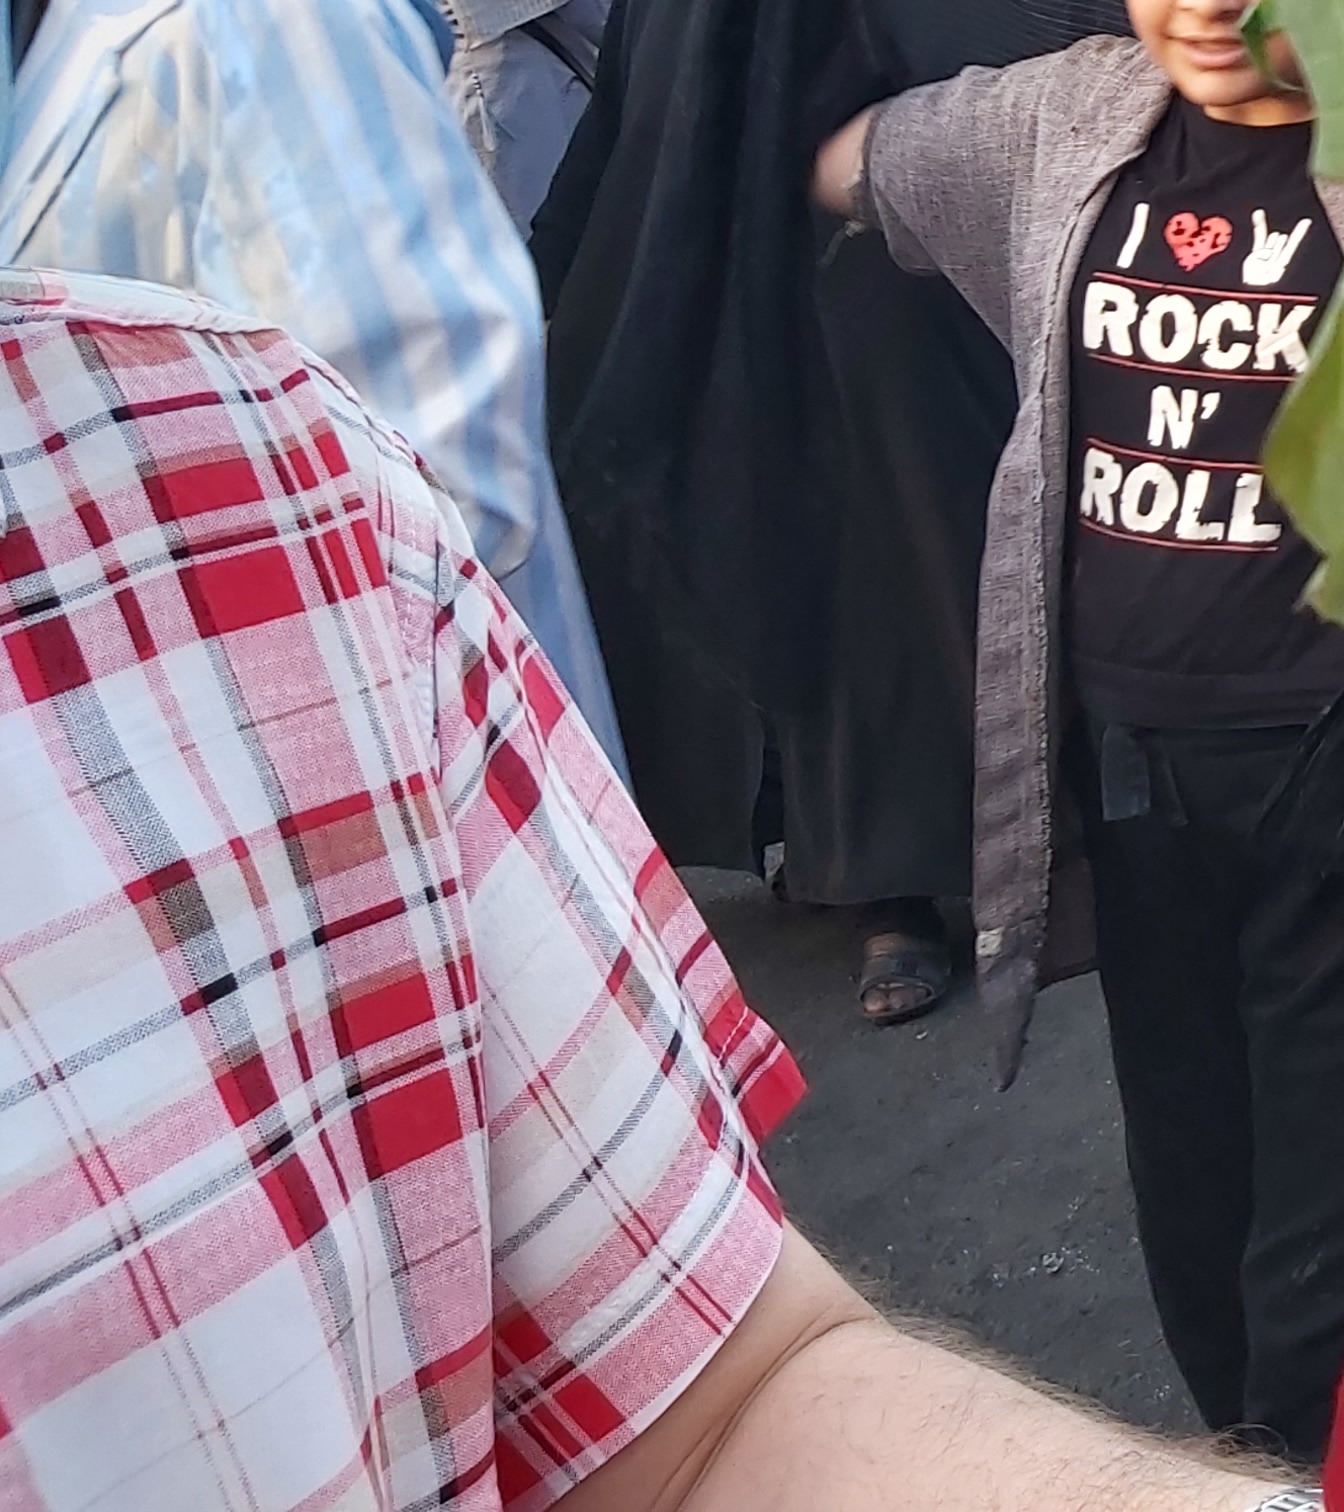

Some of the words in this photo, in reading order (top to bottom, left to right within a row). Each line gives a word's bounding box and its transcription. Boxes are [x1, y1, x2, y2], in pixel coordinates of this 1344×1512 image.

[1116, 202, 1150, 270] I
[1083, 281, 1316, 373] ROCK
[1079, 447, 1283, 543] ROLL
